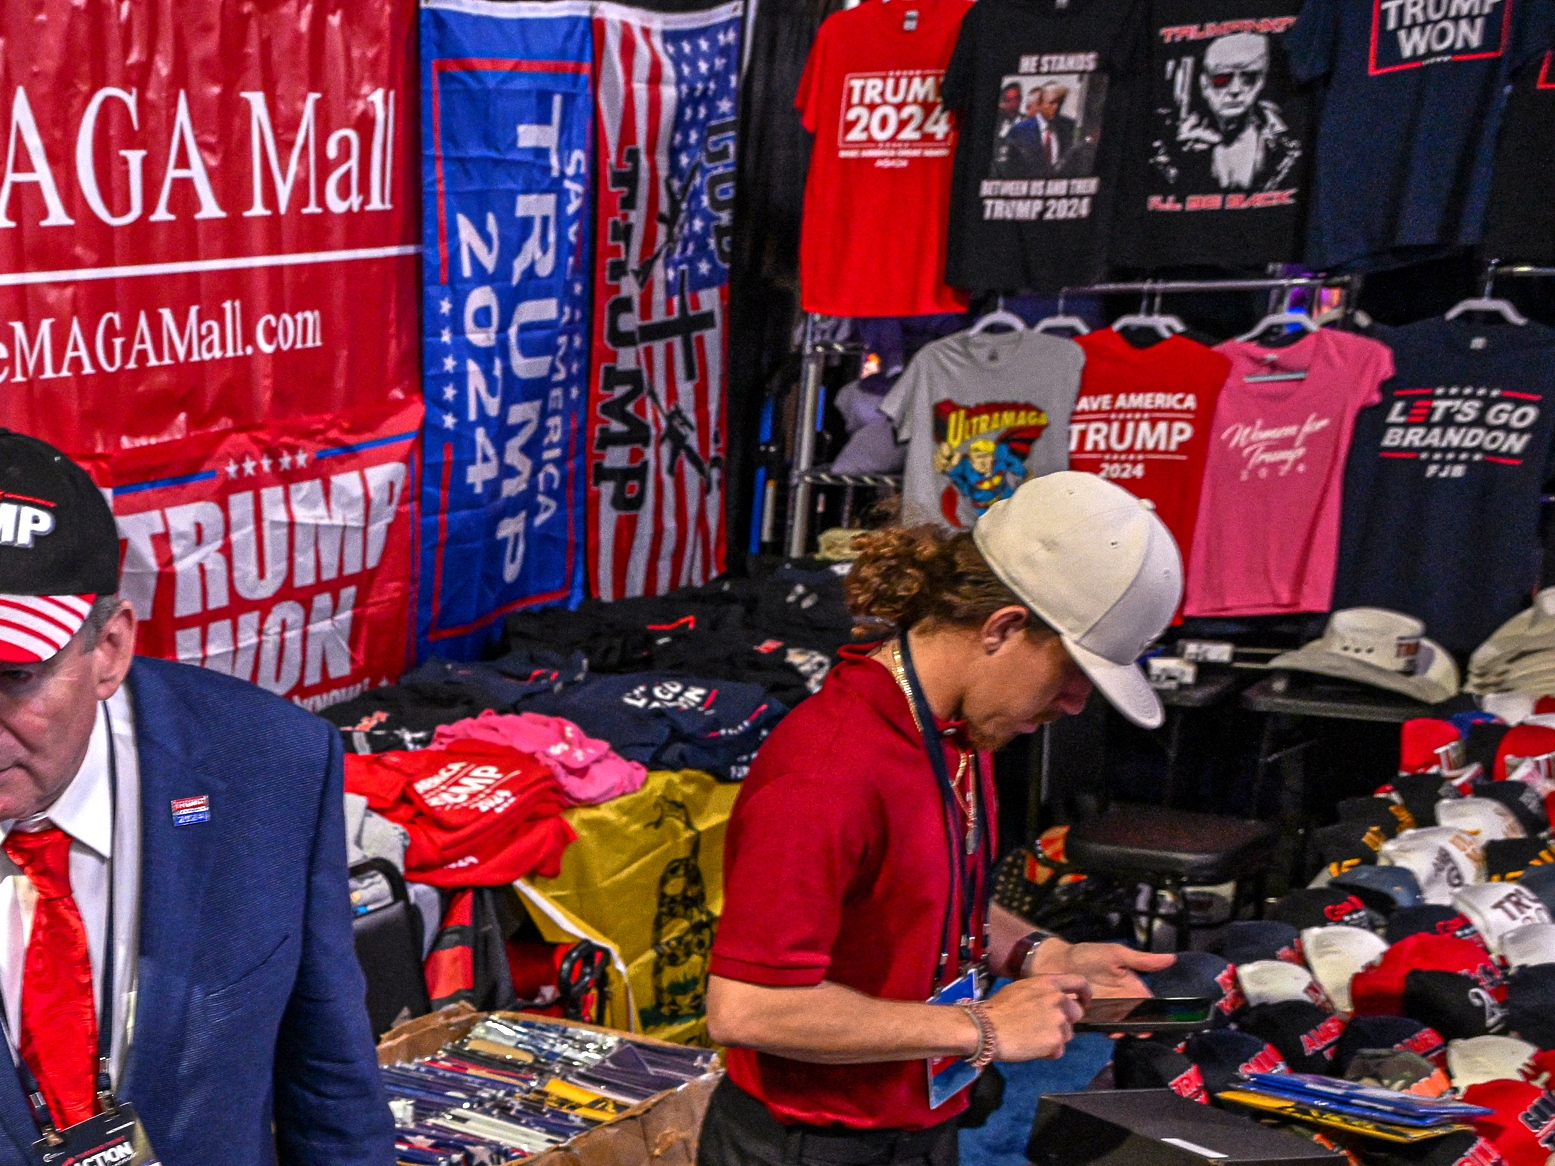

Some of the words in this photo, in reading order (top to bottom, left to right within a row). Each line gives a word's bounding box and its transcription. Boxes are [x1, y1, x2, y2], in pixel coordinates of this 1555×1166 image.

[1397, 17, 1486, 59] WON
[845, 103, 951, 141] 2024
[240, 87, 396, 217] Mall
[497, 93, 562, 583] TRUMP
[591, 145, 652, 515] TRUMP
[456, 211, 500, 494] 2024
[1075, 394, 1113, 412] AVE
[1113, 391, 1197, 411] AMERICA
[1485, 402, 1541, 429] GO
[1069, 420, 1195, 452] TRUMP
[1380, 426, 1533, 455] BRANDON
[1099, 462, 1146, 480] 2024
[116, 462, 407, 622] TRUMP
